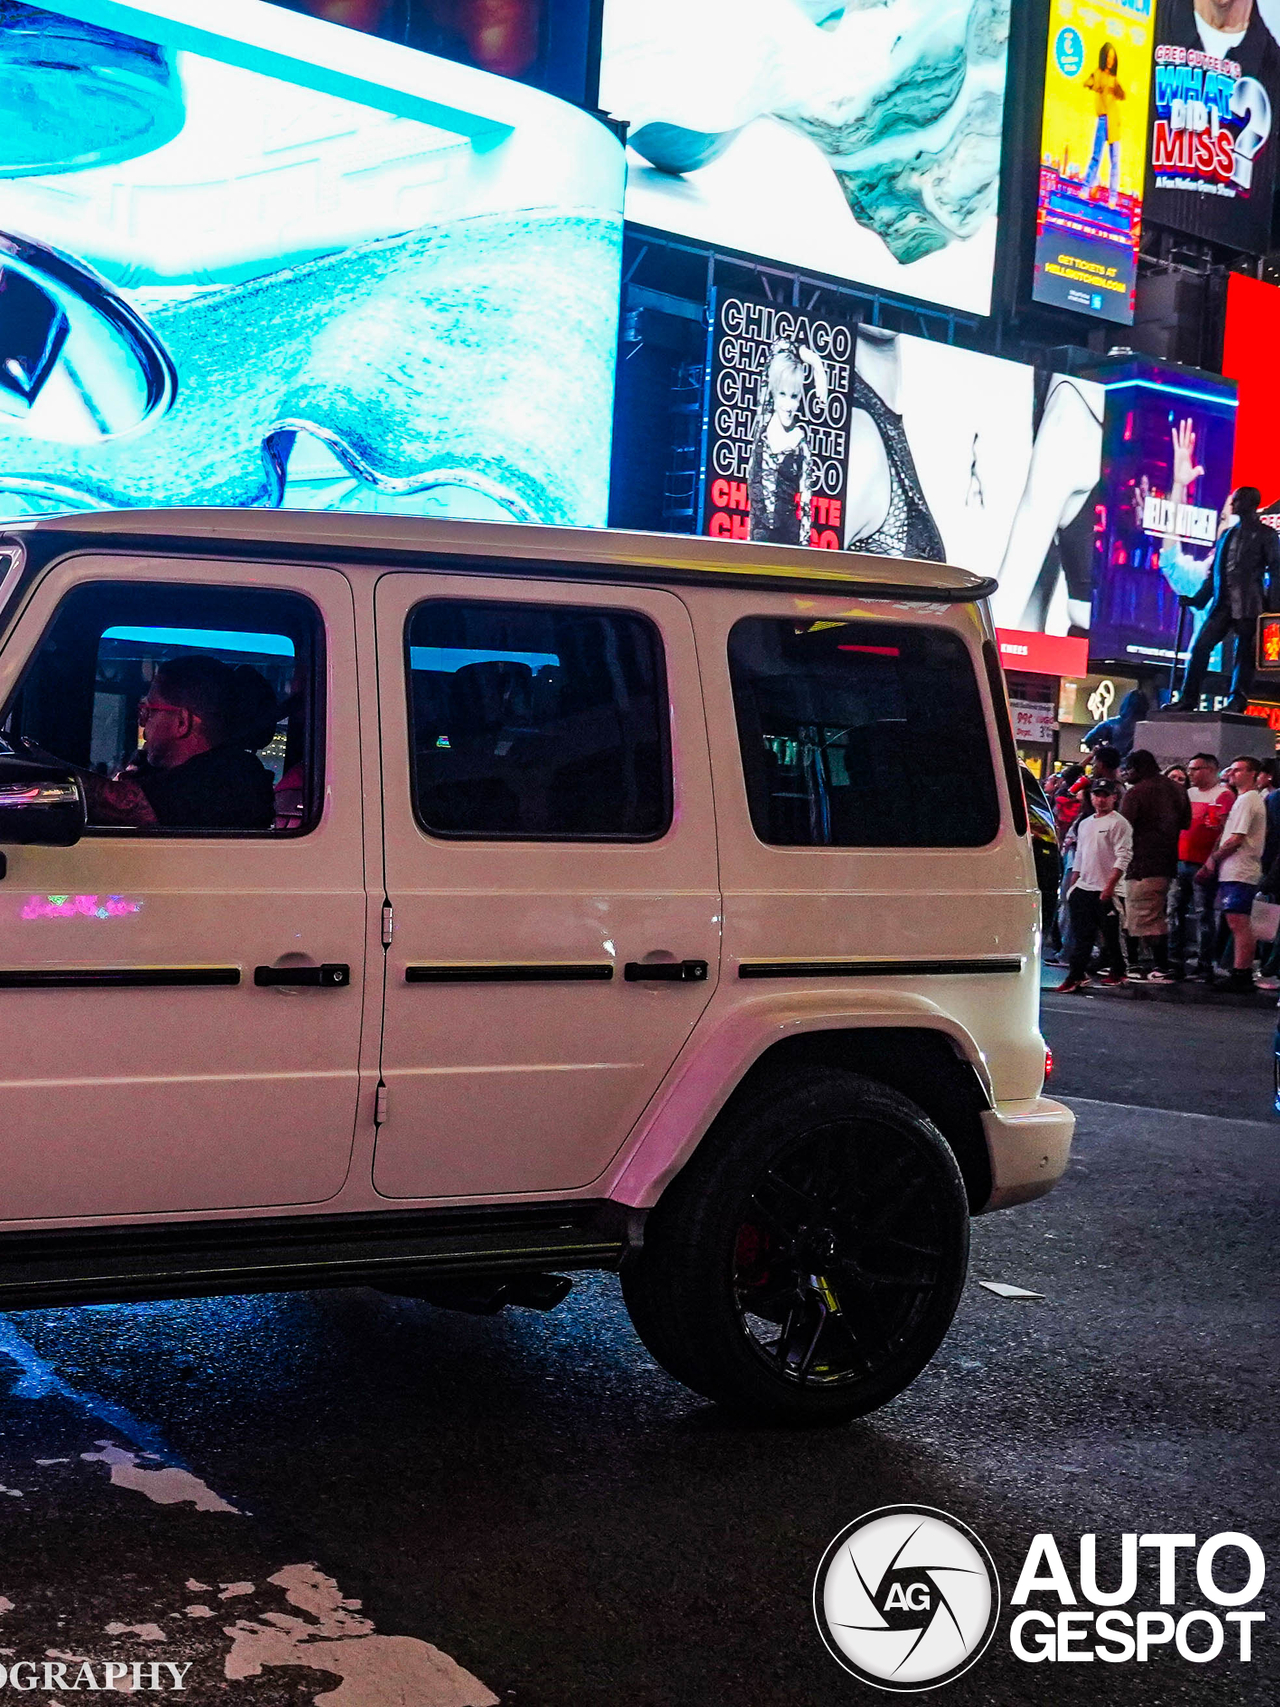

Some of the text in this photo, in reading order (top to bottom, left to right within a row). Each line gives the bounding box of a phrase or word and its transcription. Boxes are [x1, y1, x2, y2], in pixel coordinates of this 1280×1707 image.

[1155, 45, 1186, 64] GREG
[1155, 65, 1235, 119] WHAT
[1170, 99, 1220, 138] DID I
[1152, 120, 1235, 177] MISS
[721, 298, 852, 362] CHICAGO
